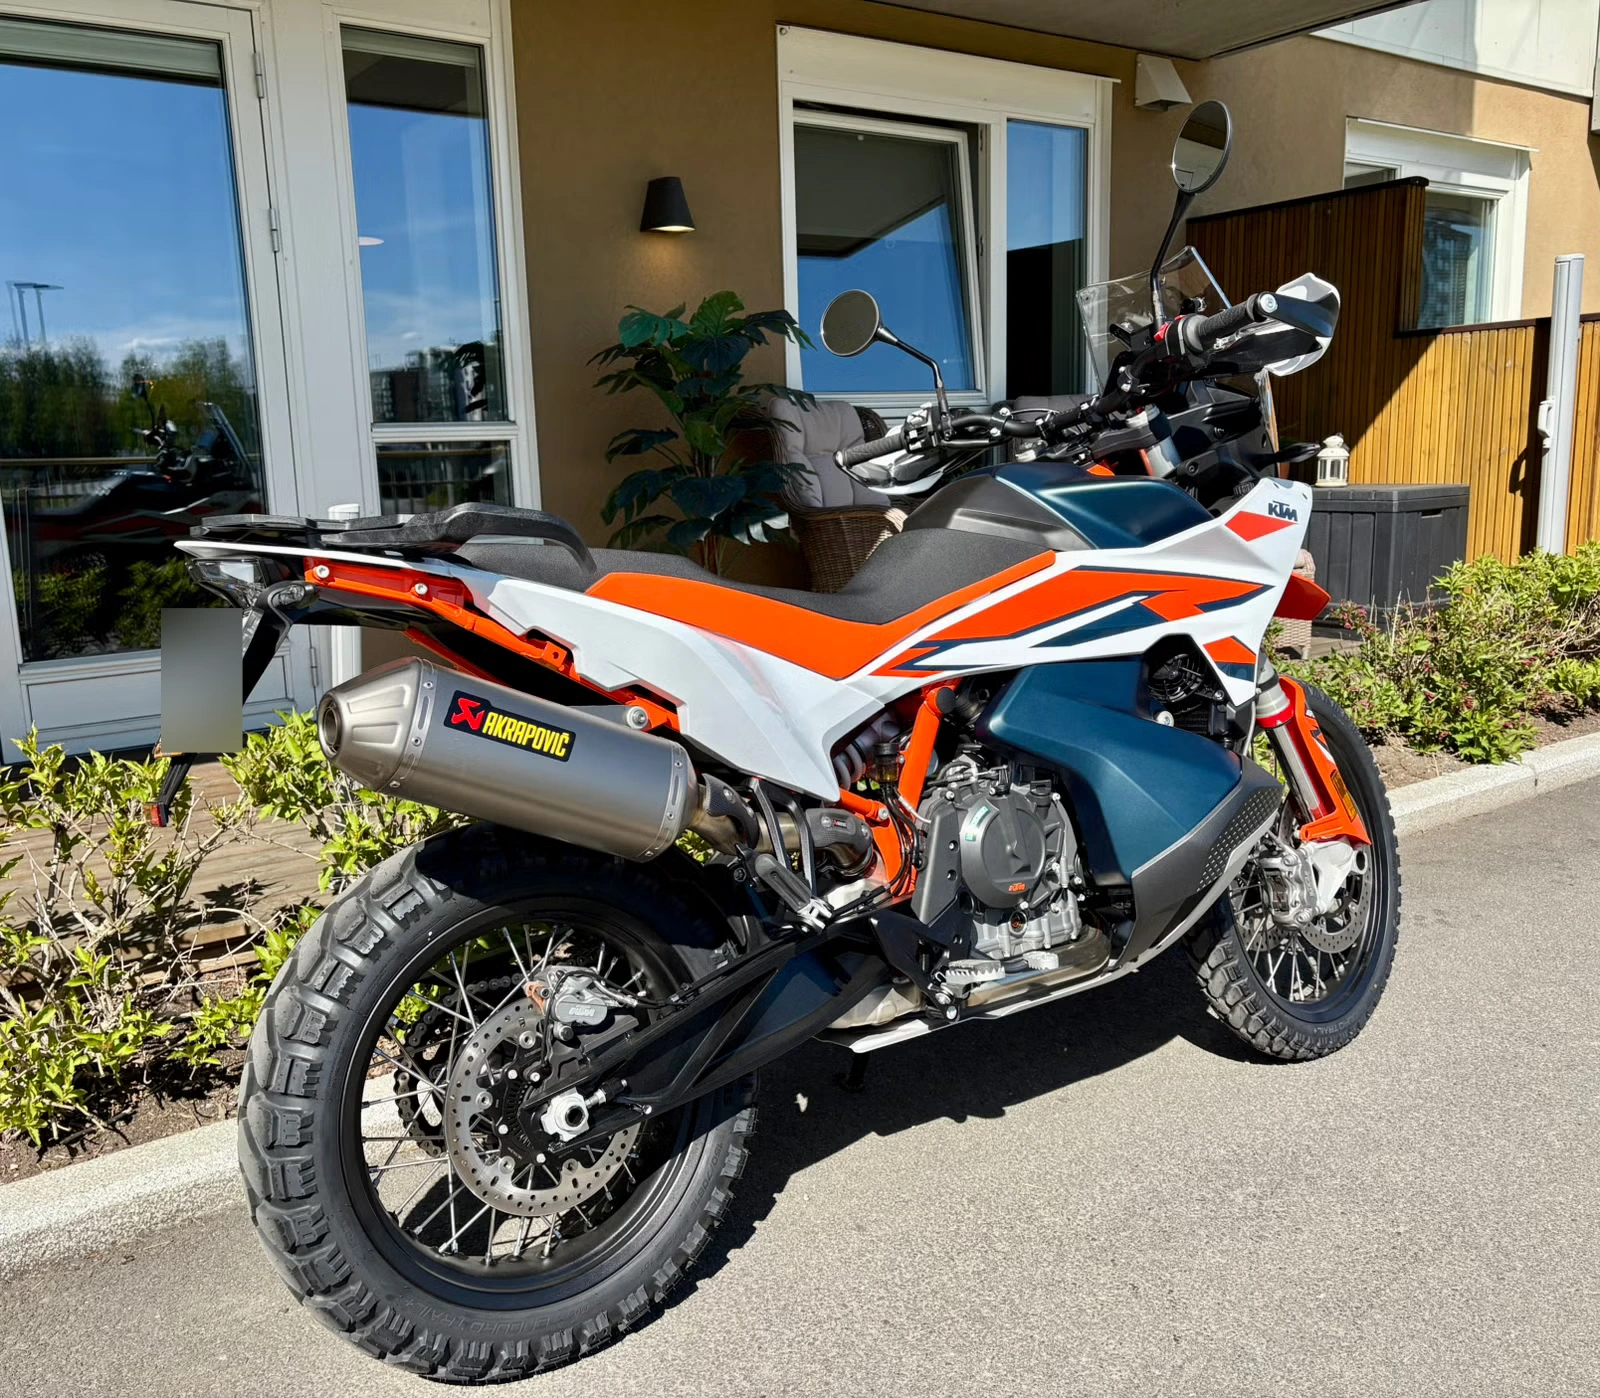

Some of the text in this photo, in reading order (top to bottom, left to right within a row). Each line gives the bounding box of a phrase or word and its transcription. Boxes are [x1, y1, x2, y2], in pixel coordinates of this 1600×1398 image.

[1268, 500, 1298, 522] KTM
[1008, 882, 1026, 892] KTM
[568, 1004, 596, 1017] KTM
